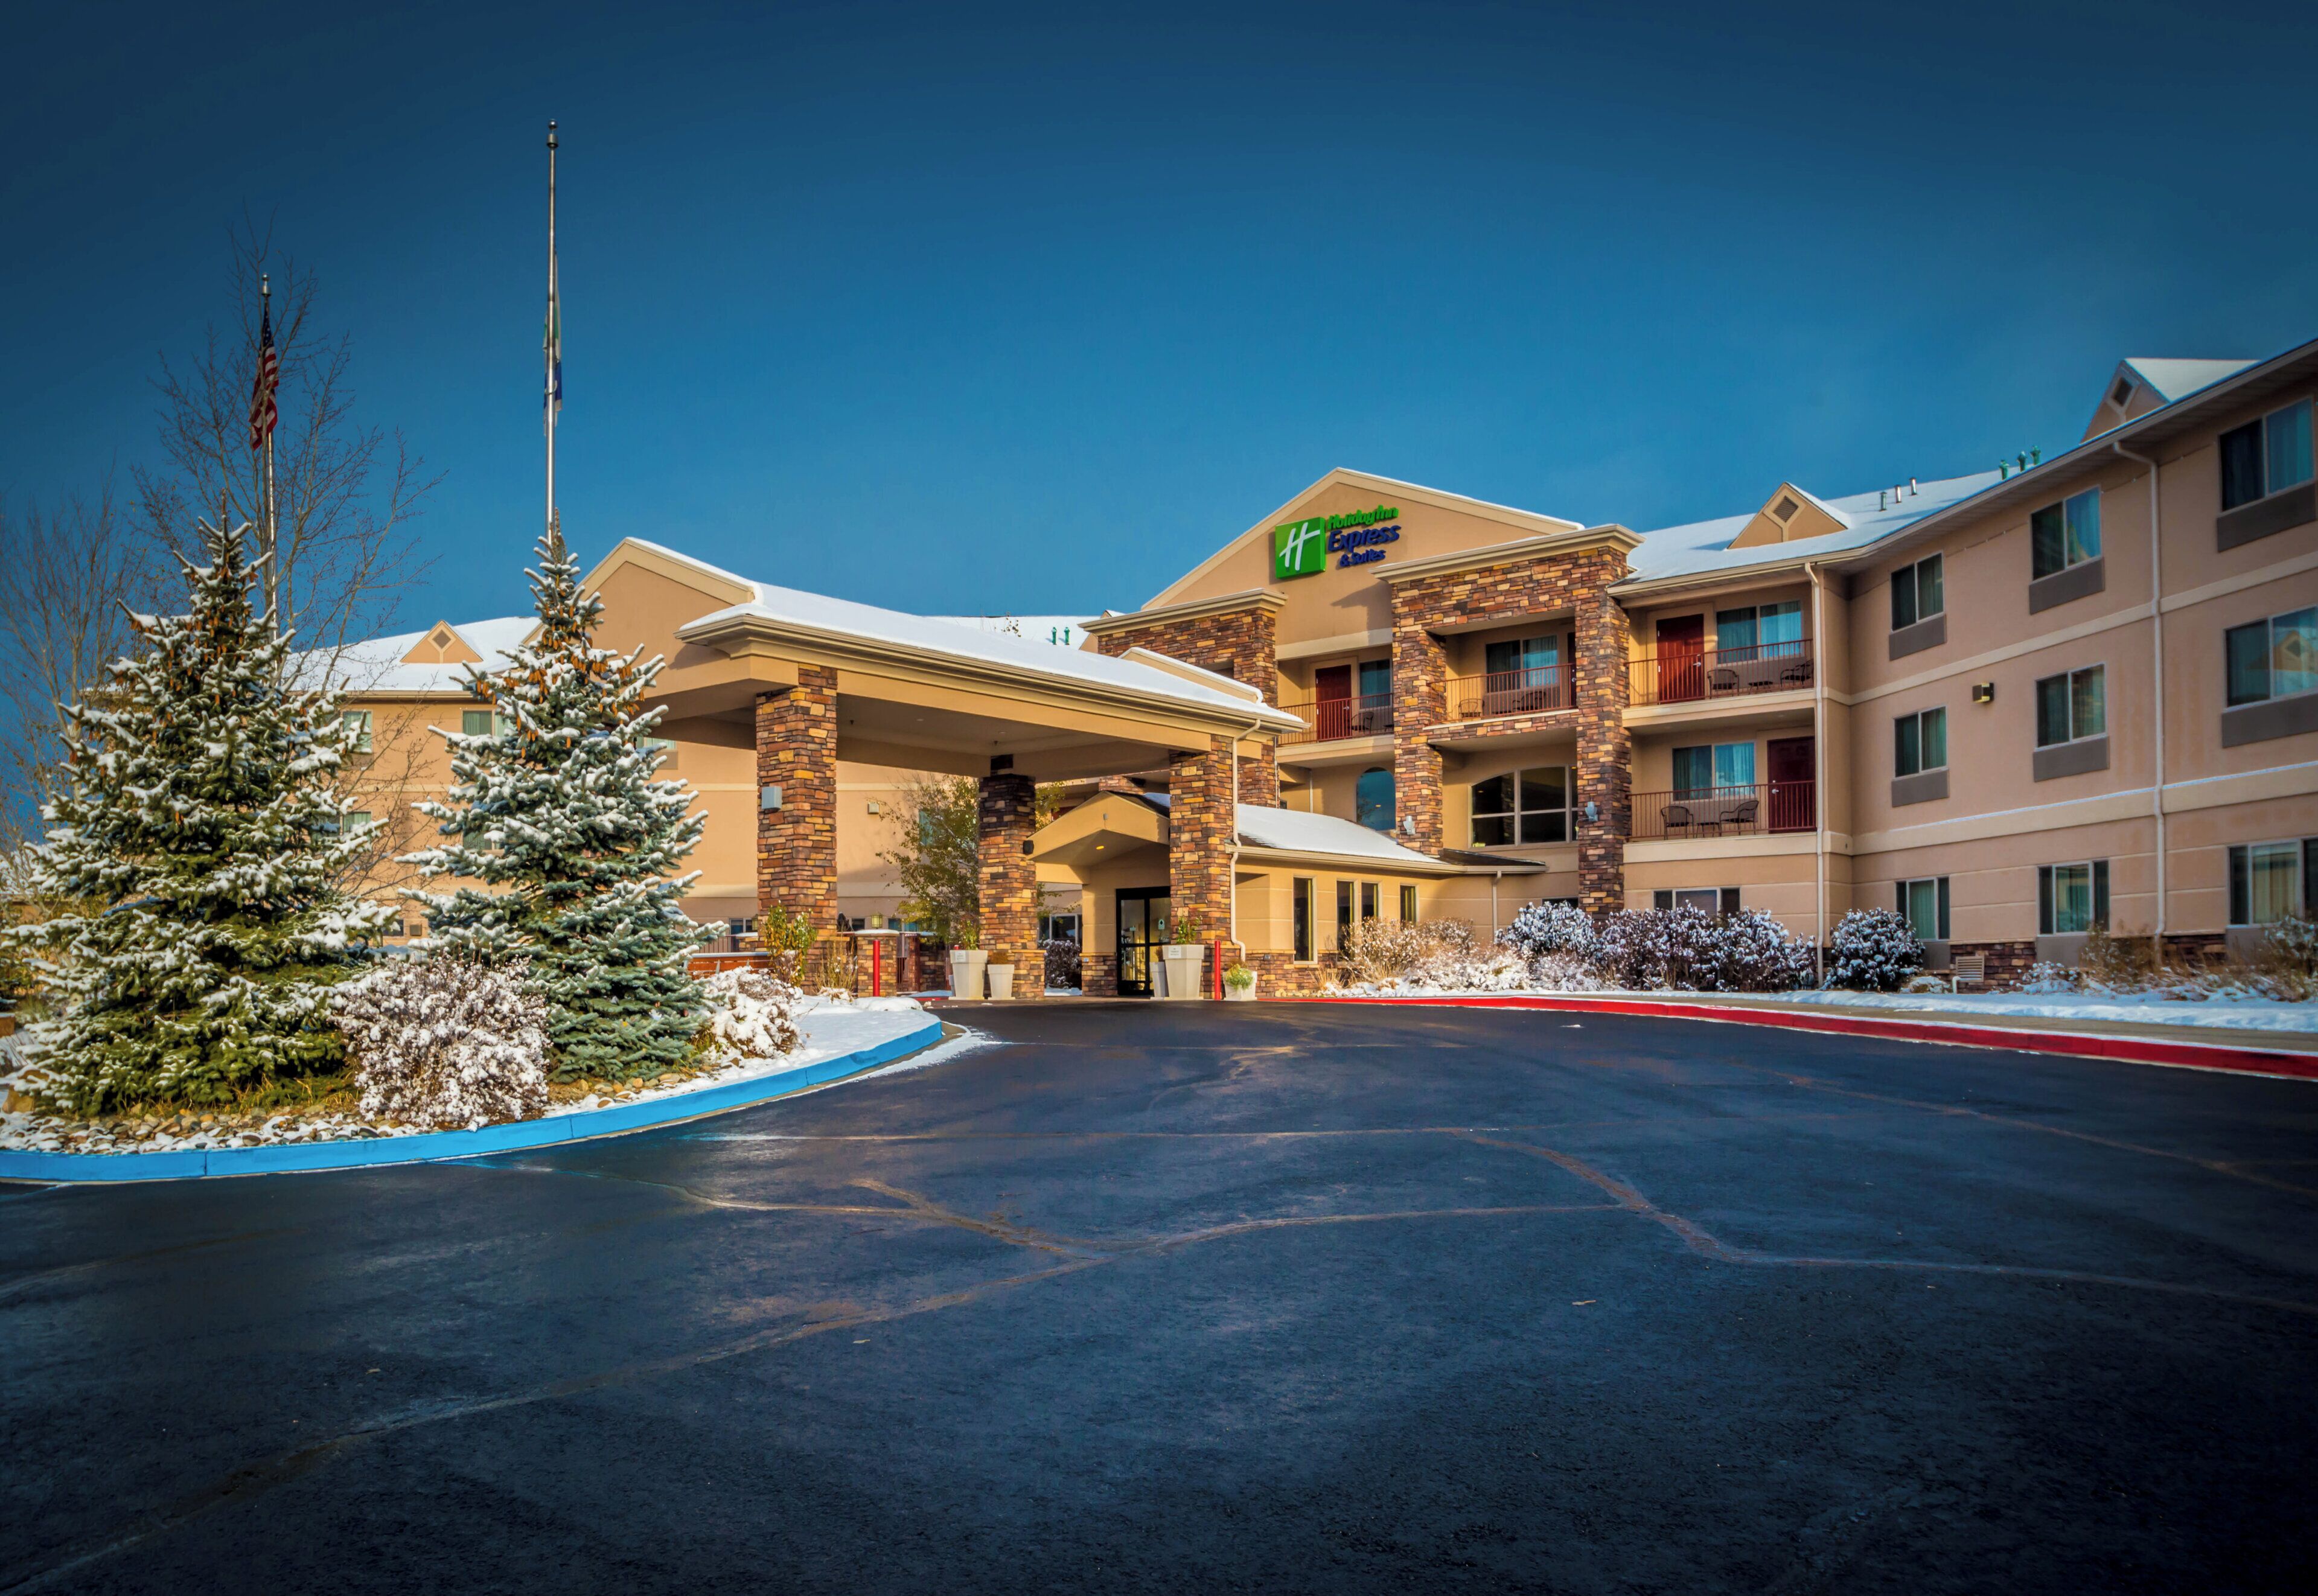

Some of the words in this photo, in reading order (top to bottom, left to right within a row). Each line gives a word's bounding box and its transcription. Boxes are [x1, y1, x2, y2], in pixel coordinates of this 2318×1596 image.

[1327, 509, 1376, 530] Holiday
[1376, 505, 1399, 520] Inn
[1327, 525, 1402, 553] Express
[1339, 554, 1351, 567] &
[1350, 549, 1387, 566] Suites
